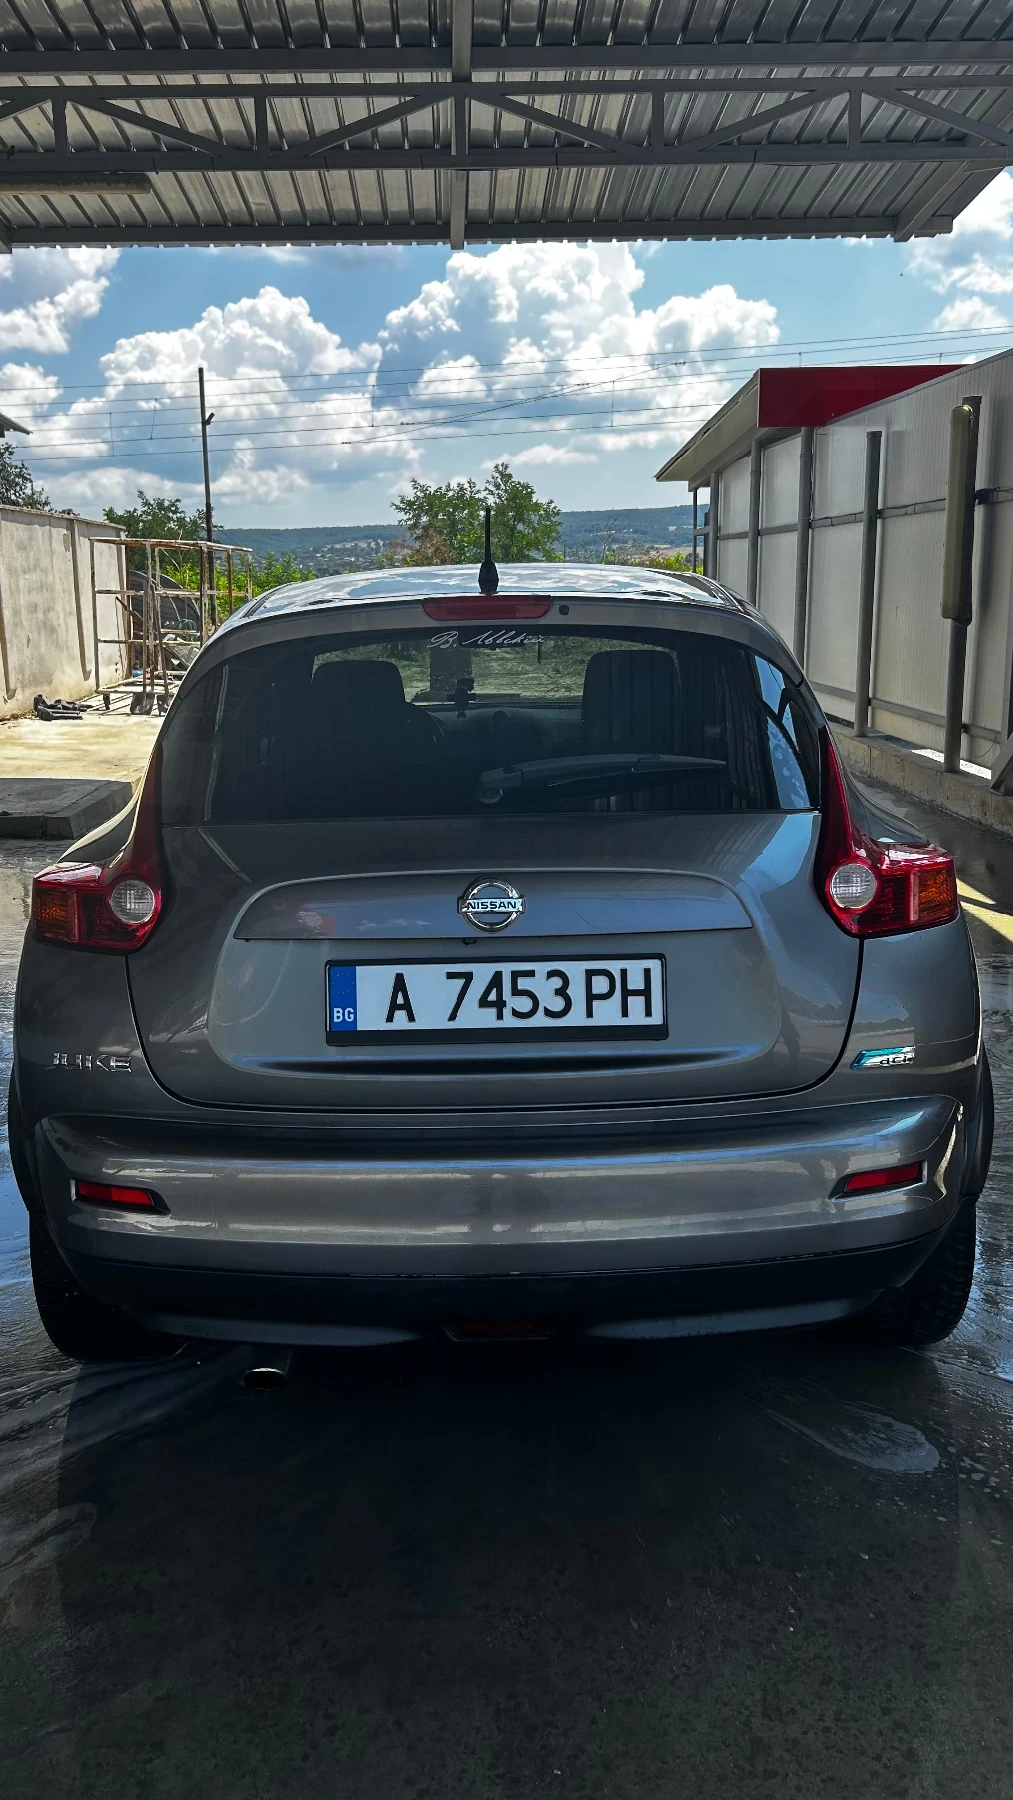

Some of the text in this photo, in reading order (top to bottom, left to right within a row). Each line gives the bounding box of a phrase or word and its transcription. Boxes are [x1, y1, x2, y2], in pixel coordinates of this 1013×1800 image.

[467, 900, 517, 910] NISSAN
[385, 972, 416, 1023] A
[445, 969, 573, 1022] 7453
[333, 1008, 355, 1023] BG
[44, 1052, 132, 1073] JUKE
